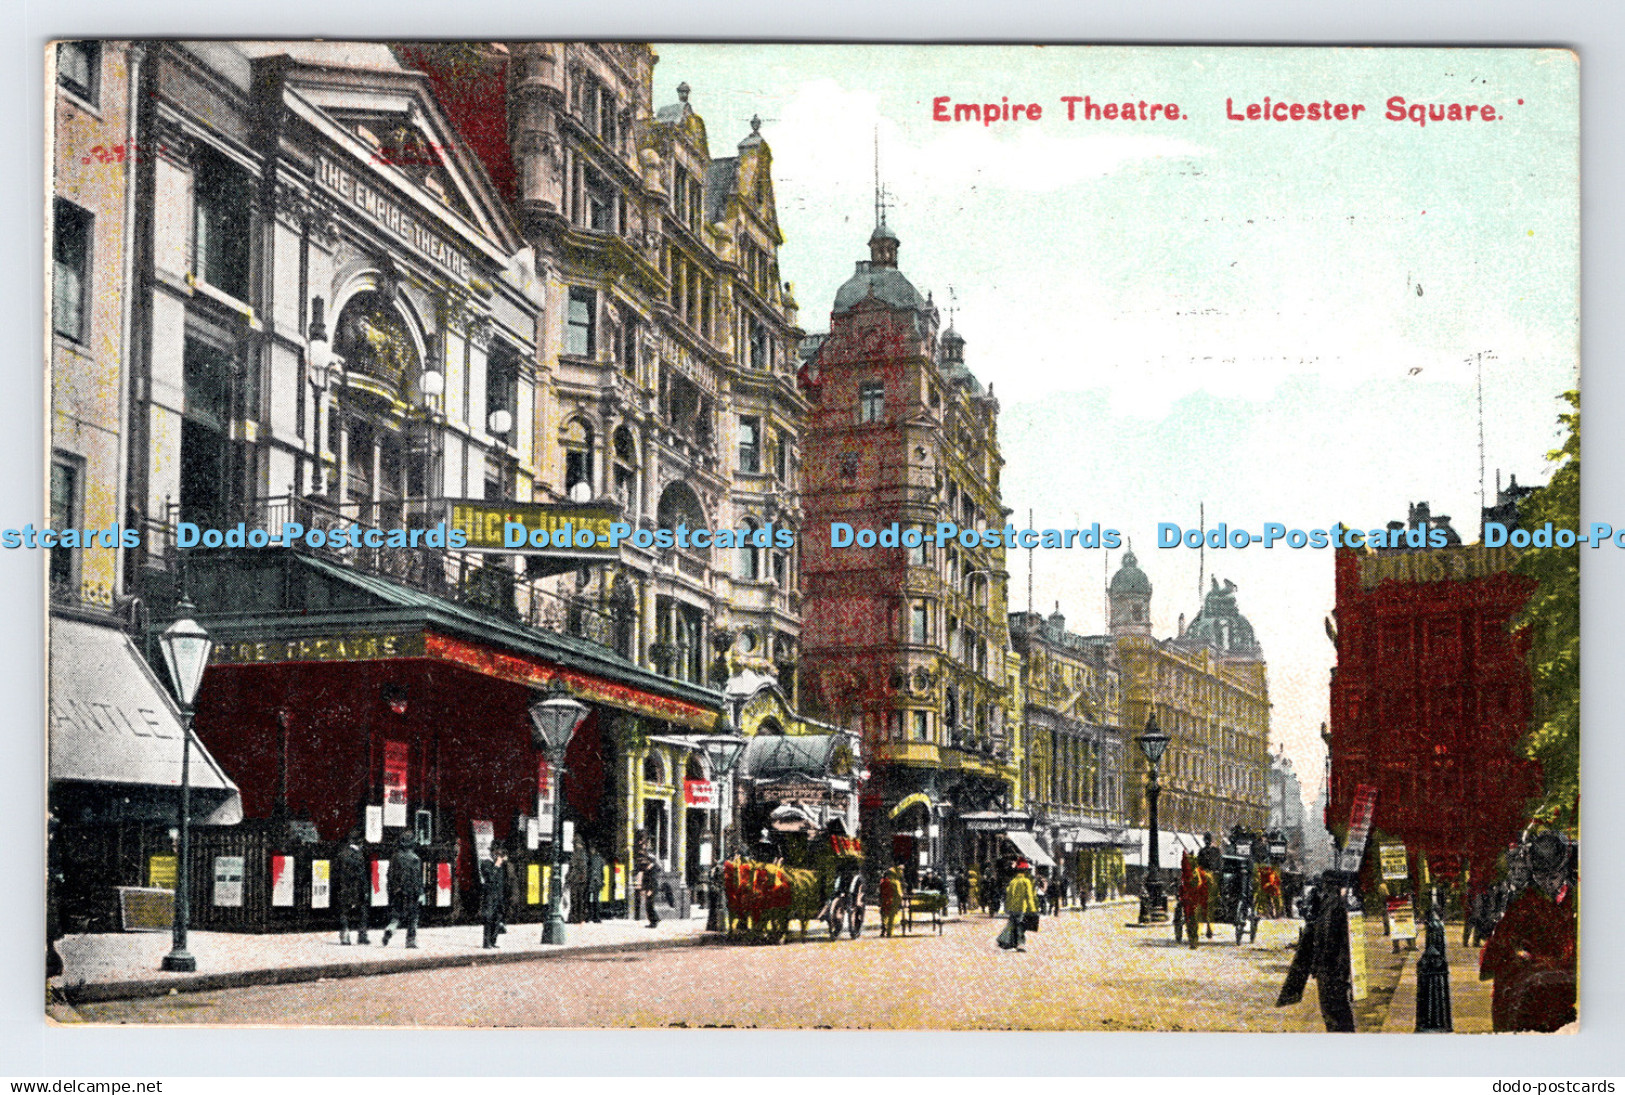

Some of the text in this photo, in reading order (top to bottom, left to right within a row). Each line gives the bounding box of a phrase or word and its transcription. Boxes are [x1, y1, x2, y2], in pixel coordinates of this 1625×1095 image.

[318, 155, 471, 281] THE EMPIRE THEATRE
